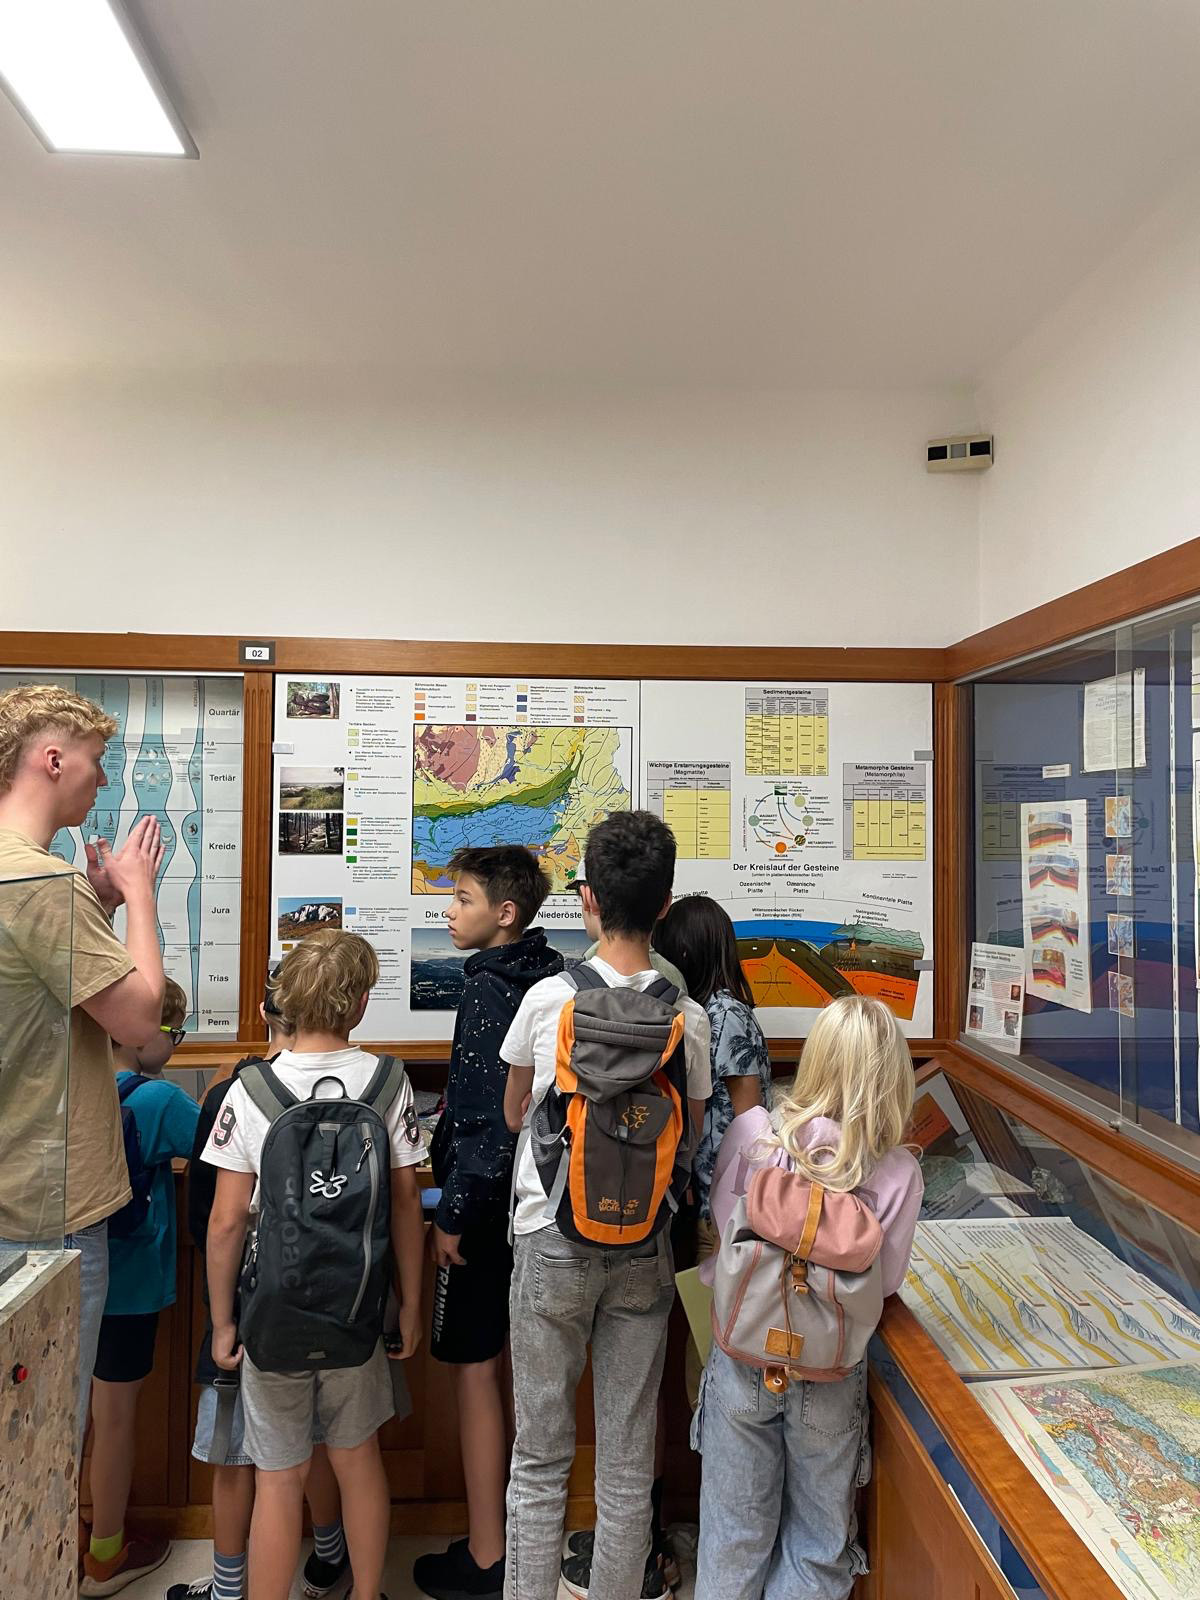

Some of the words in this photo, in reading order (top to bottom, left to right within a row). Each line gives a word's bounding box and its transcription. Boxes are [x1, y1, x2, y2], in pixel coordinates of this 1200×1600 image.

[209, 708, 240, 716] Quartär
[749, 863, 785, 871] Kreislauf
[537, 911, 582, 919] Niederöste
[208, 974, 229, 982] Trias
[208, 1018, 230, 1026] Perm
[212, 1103, 238, 1149] 9
